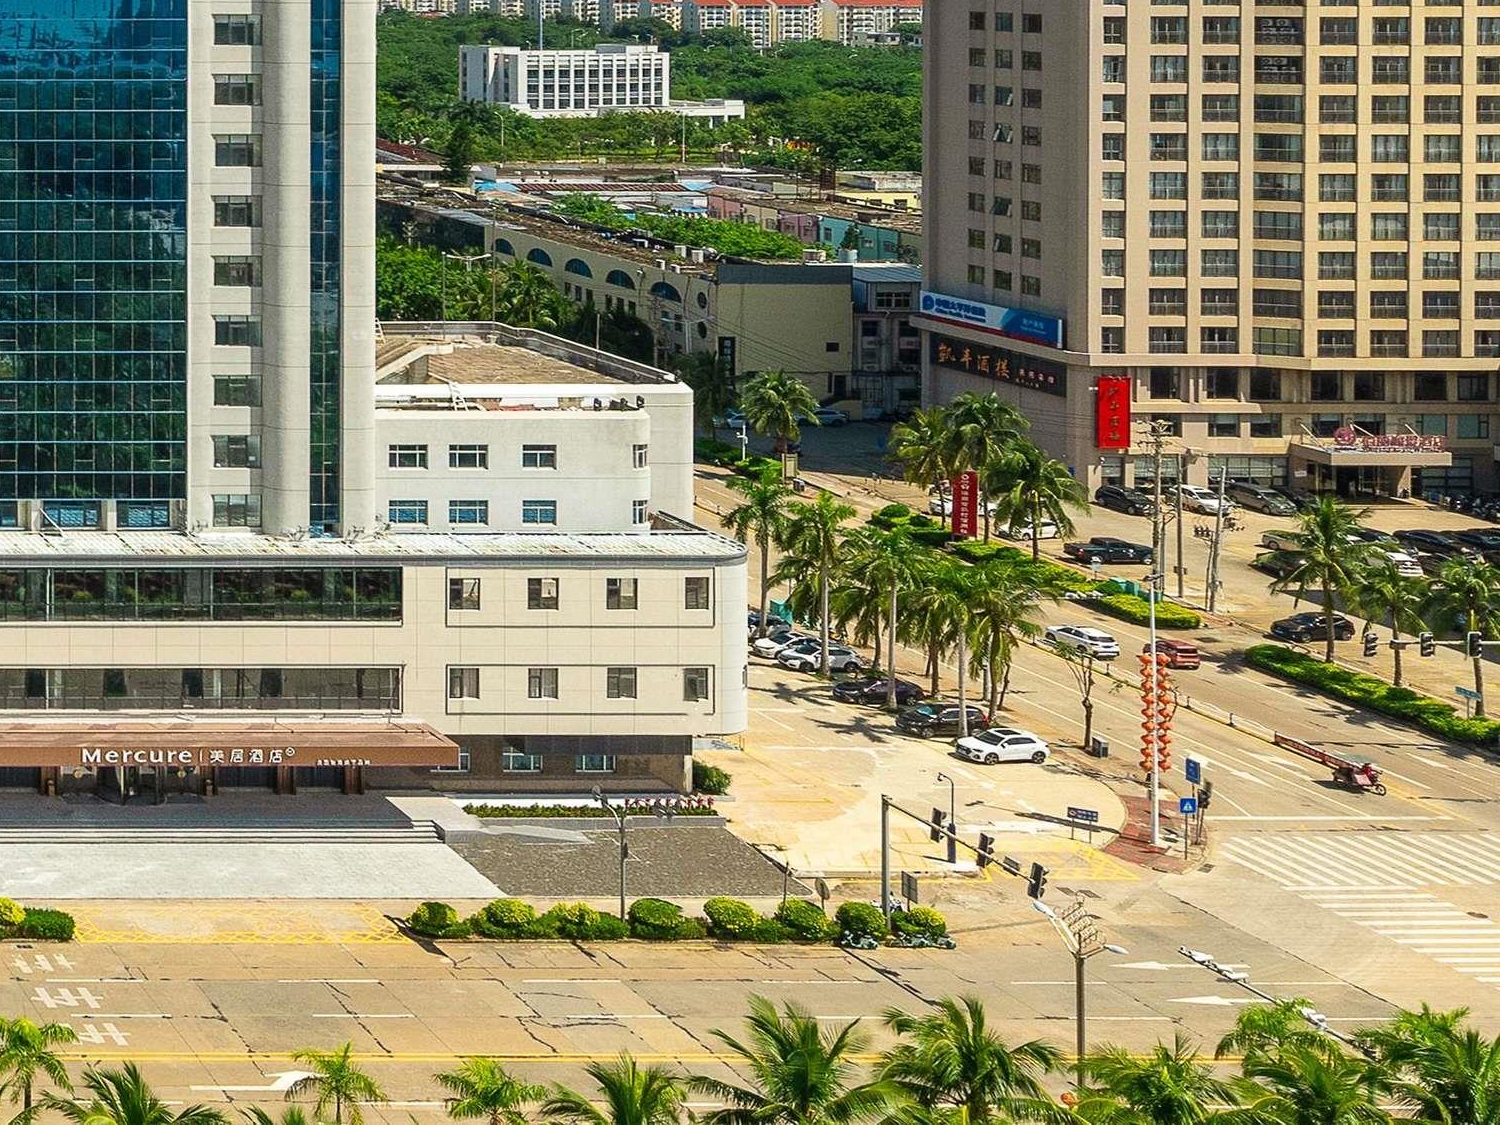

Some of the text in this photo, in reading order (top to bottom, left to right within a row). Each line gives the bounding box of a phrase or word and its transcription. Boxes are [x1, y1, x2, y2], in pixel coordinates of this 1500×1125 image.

[81, 748, 193, 764] Mercure
[209, 748, 284, 764] 美居酒店
